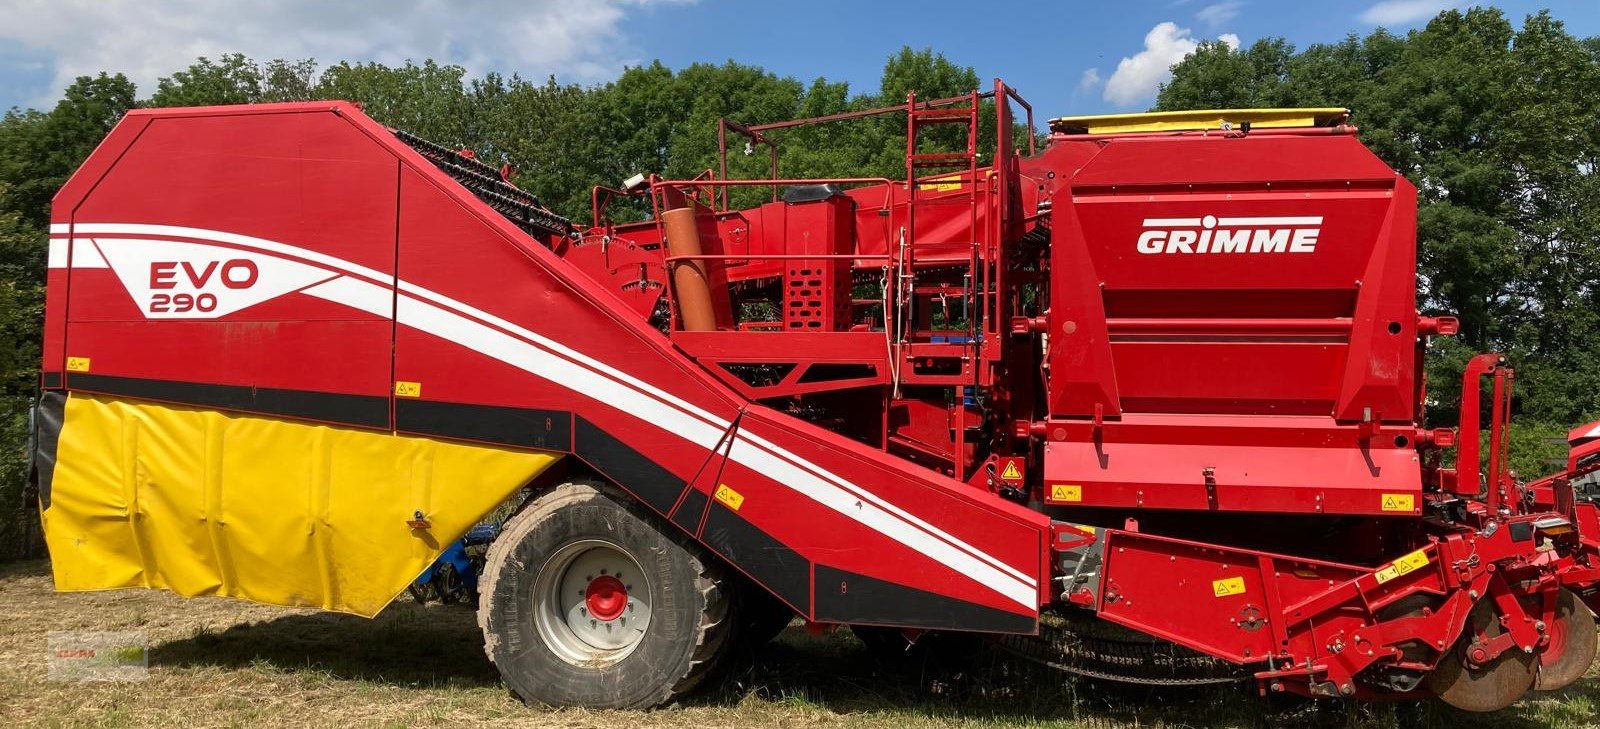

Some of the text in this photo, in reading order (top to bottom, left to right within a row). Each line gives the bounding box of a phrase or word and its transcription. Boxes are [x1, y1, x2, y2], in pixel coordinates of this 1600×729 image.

[1137, 215, 1323, 253] GRIMME
[150, 259, 259, 289] EVO
[150, 293, 217, 312] 290
